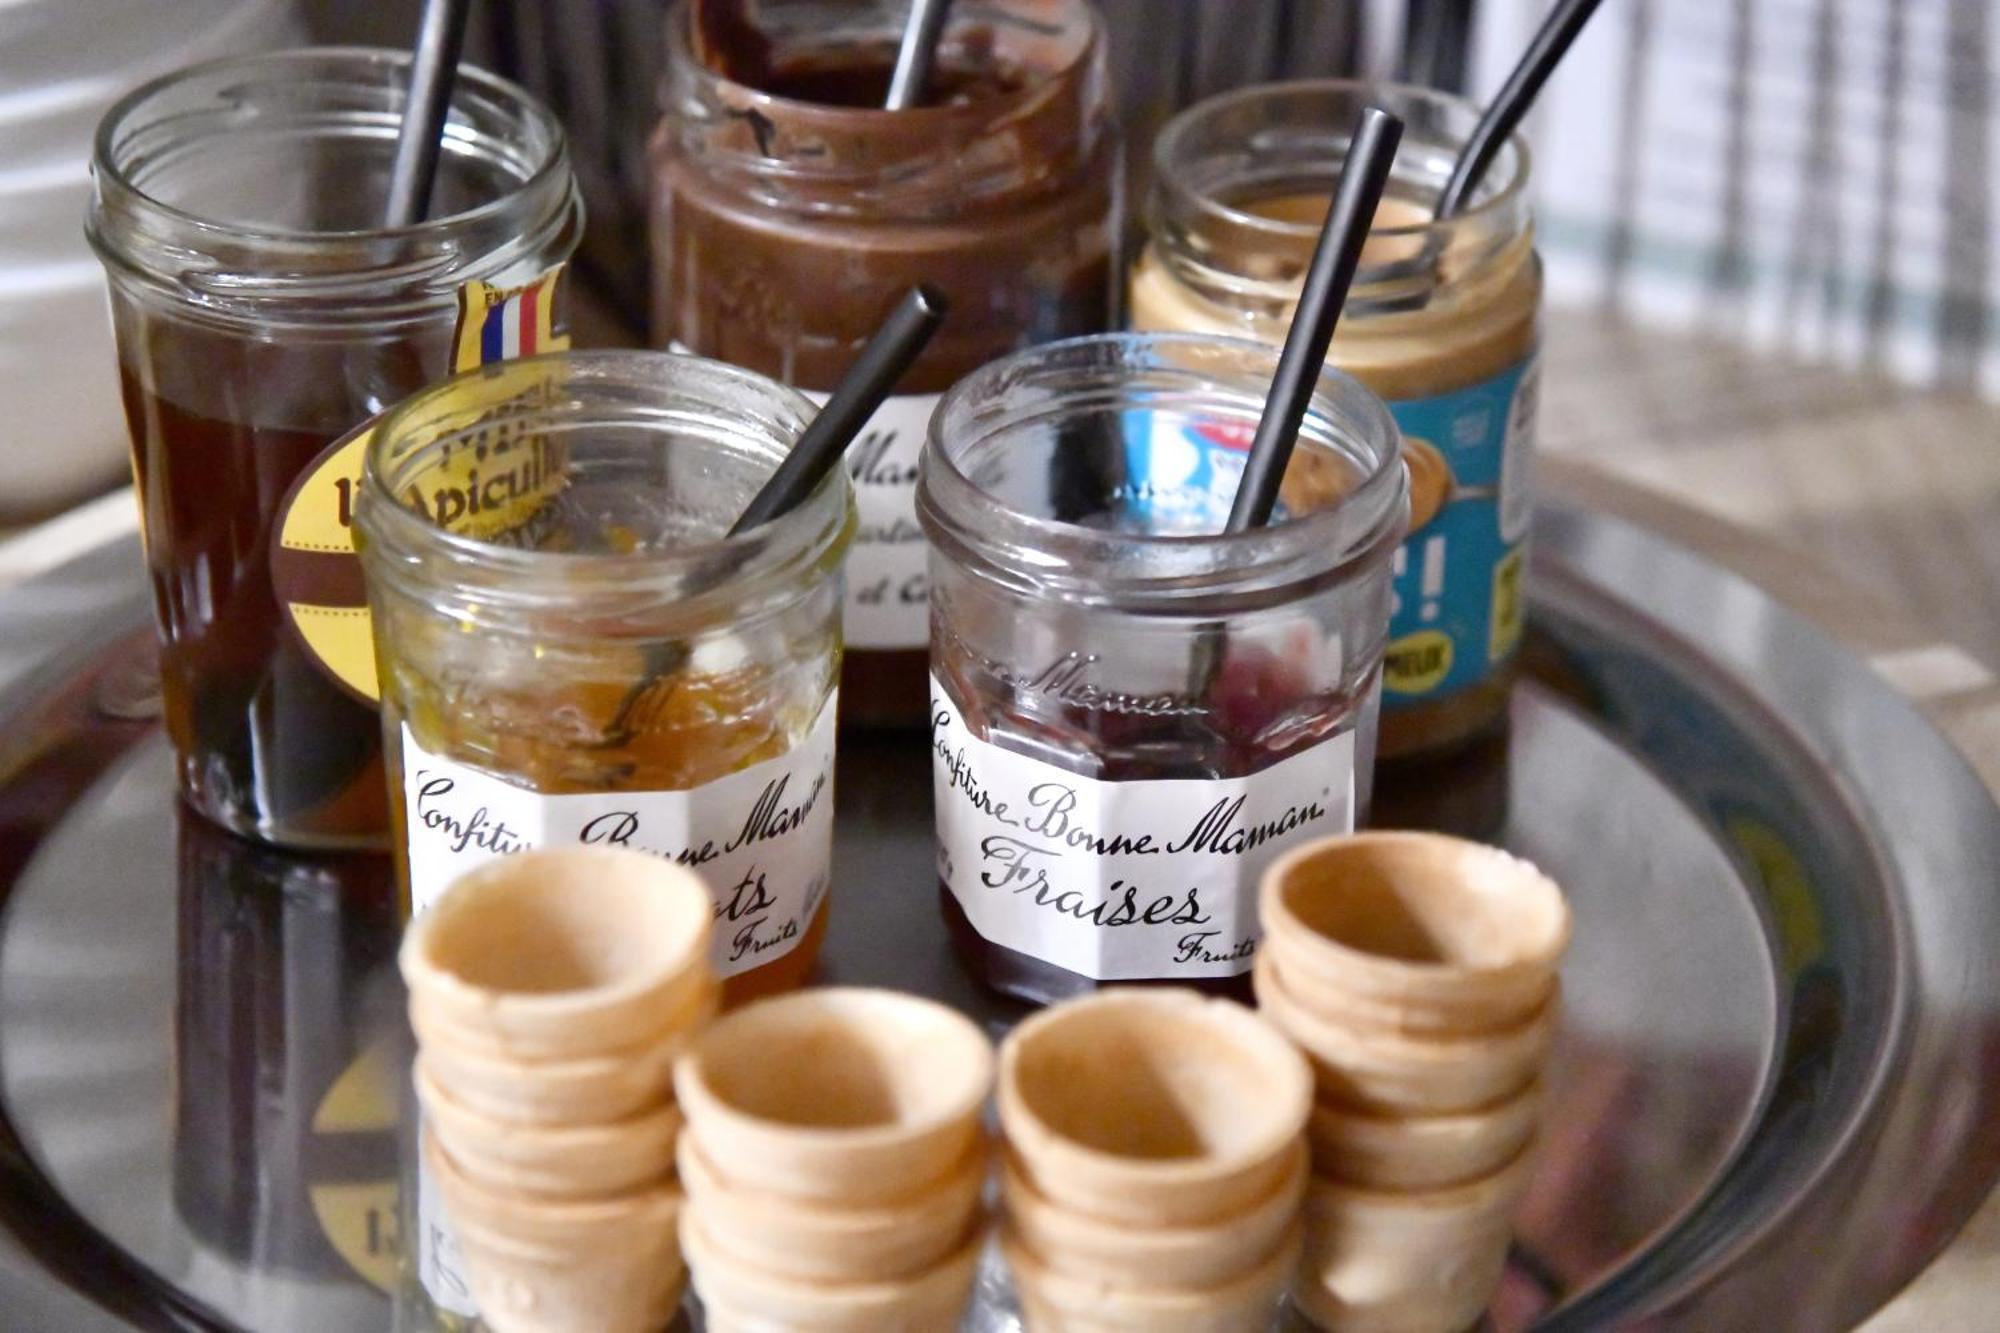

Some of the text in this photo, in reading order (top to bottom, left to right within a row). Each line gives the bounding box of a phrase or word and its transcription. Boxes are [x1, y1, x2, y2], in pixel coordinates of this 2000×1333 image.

[933, 699, 1326, 856] Confiture Bonne Maman
[980, 834, 1212, 926] Fraises
[729, 916, 799, 962] Fruits
